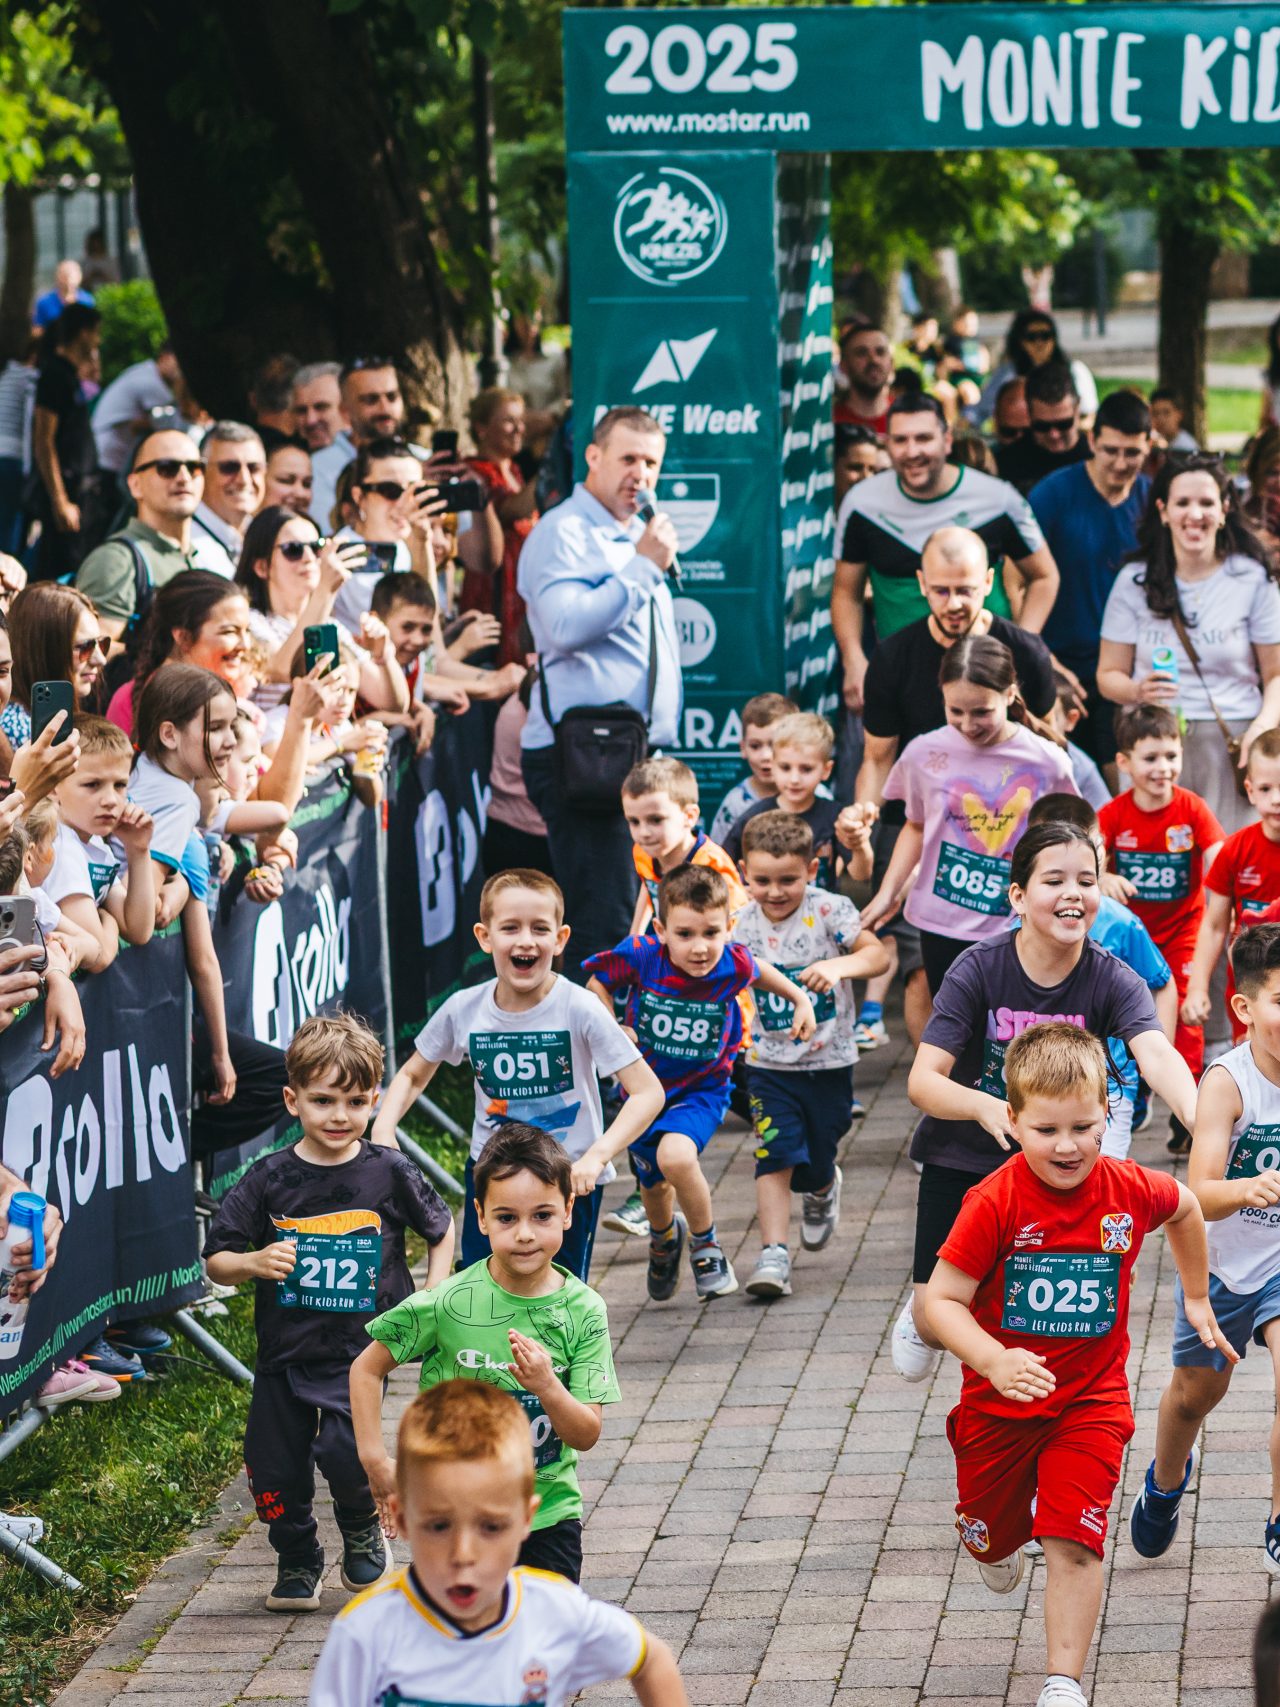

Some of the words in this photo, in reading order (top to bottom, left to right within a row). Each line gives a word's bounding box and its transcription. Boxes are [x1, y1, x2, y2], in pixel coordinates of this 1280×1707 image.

[604, 22, 799, 95] 2025
[920, 26, 1146, 131] MONTE
[606, 108, 811, 134] www.mostar.run
[682, 402, 762, 434] Week
[949, 863, 1003, 899] 085
[1129, 866, 1177, 888] 228
[651, 1013, 710, 1043] 058
[493, 1051, 550, 1081] 051
[1240, 1207, 1268, 1220] FOOD
[299, 1256, 359, 1290] 212
[1014, 1255, 1033, 1264] MONTE
[1093, 1256, 1110, 1264] ISCA
[302, 1294, 314, 1306] LET
[315, 1297, 337, 1308] KIDS
[338, 1297, 354, 1308] RUN
[1027, 1277, 1100, 1314] 025
[1032, 1319, 1047, 1332] LET
[1049, 1321, 1073, 1333] KIDS
[1075, 1320, 1091, 1333] RUN
